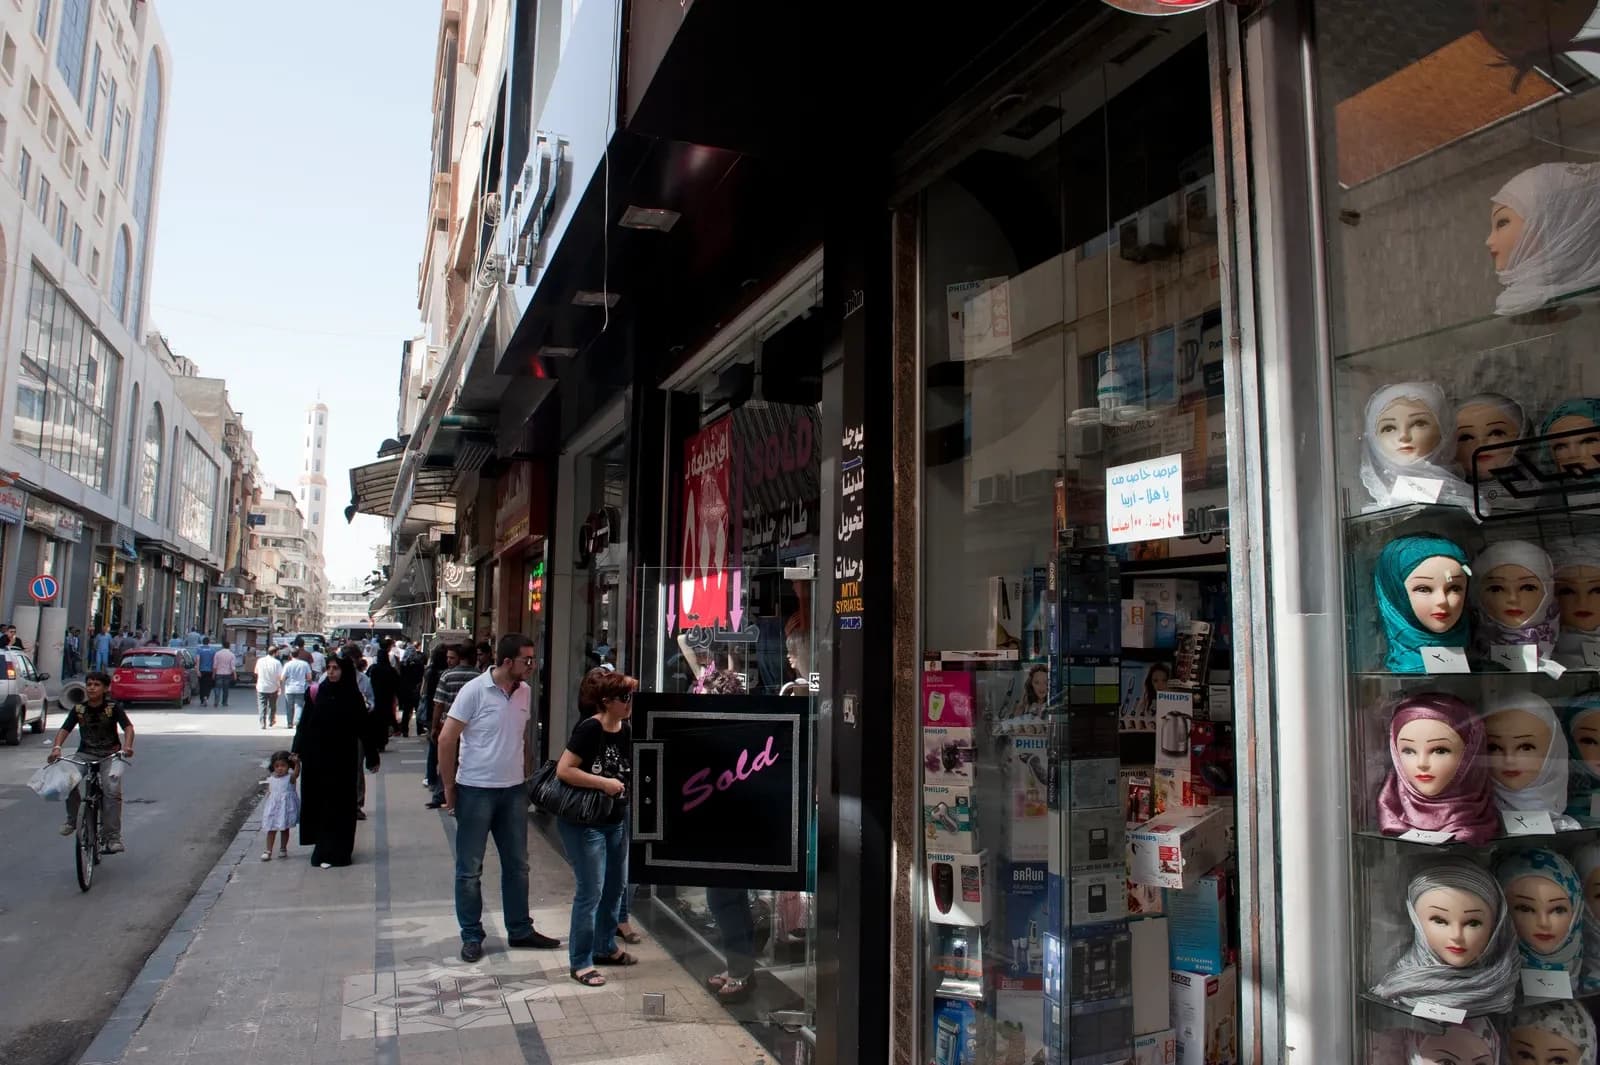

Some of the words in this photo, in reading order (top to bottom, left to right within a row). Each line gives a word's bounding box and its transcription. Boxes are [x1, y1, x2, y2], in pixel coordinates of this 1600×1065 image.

[948, 282, 980, 293] PHILIPS
[842, 424, 864, 451] يوجد
[751, 415, 813, 487] SOLD
[842, 466, 864, 501] لدينا
[837, 505, 864, 541] تحويل
[835, 556, 864, 582] وحدات
[842, 582, 859, 597] MTN
[835, 598, 864, 614] SYRIATEL
[1158, 692, 1191, 702] PHILIPS
[681, 735, 780, 814] Sold
[1120, 770, 1148, 778] PHILIPS
[1131, 834, 1157, 842] PHILIPS
[927, 853, 955, 862] PHILIPS
